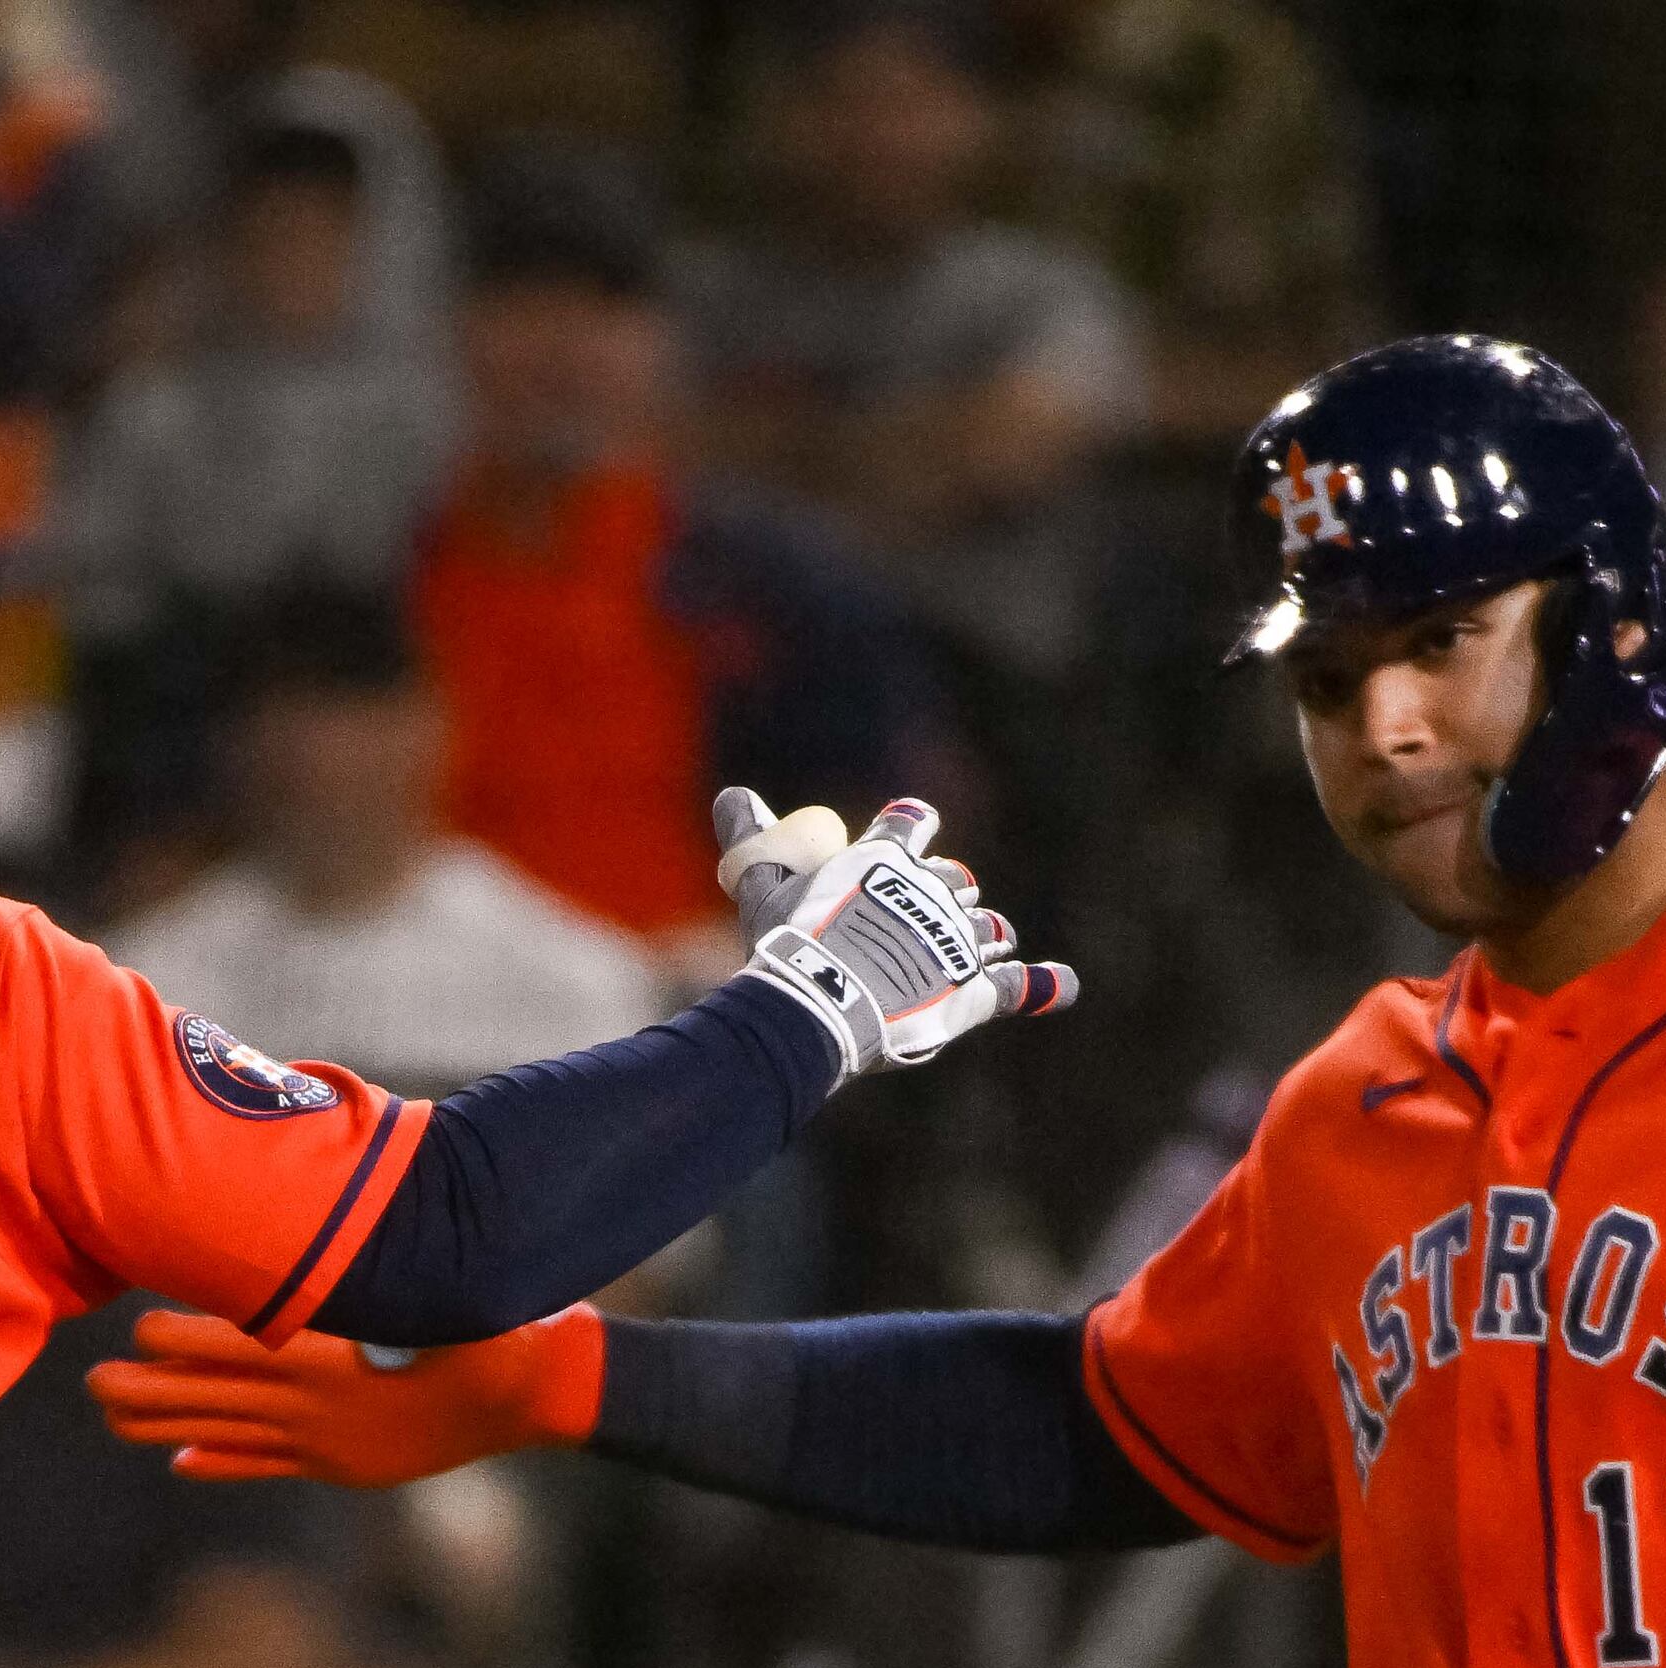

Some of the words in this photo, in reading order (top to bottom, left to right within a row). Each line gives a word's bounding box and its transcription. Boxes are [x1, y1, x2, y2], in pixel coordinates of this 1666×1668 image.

[1269, 460, 1348, 551] H
[871, 878, 969, 972] Franklin
[187, 1018, 238, 1064] HOUS
[277, 1074, 330, 1108] ASTR
